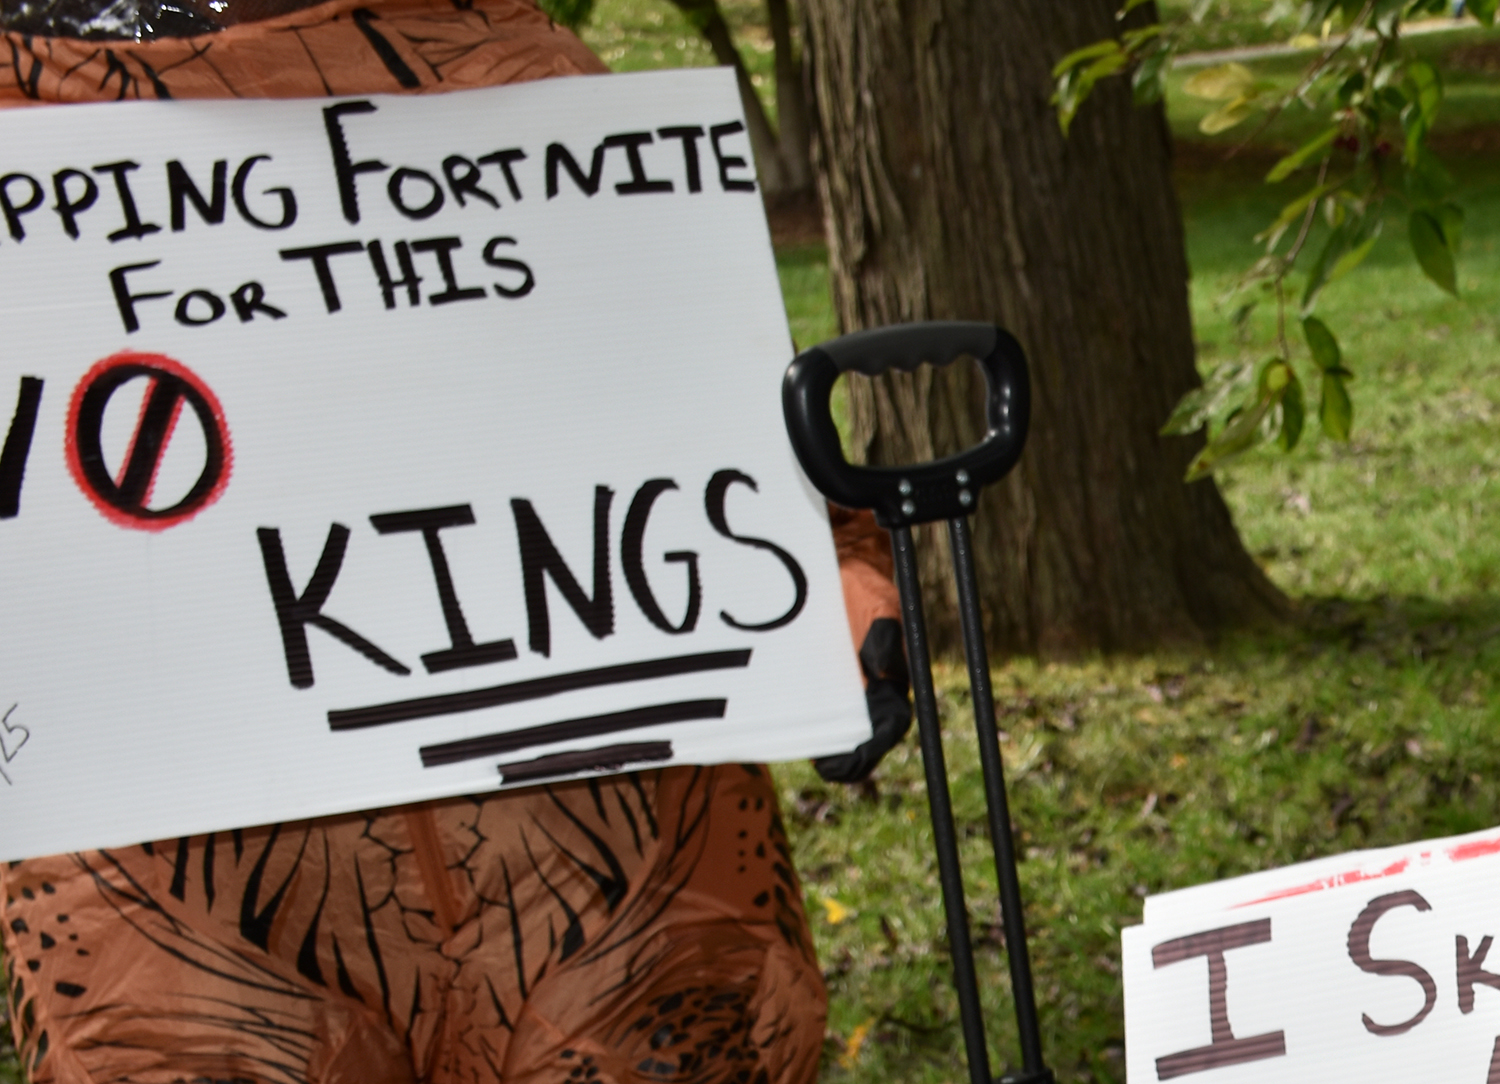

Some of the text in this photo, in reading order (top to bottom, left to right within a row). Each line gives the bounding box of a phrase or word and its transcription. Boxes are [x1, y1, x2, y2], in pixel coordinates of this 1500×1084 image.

[322, 100, 757, 225] FORTNITE
[108, 236, 536, 334] FOR THIS
[256, 468, 808, 690] KINGS
[1151, 917, 1286, 1081] I
